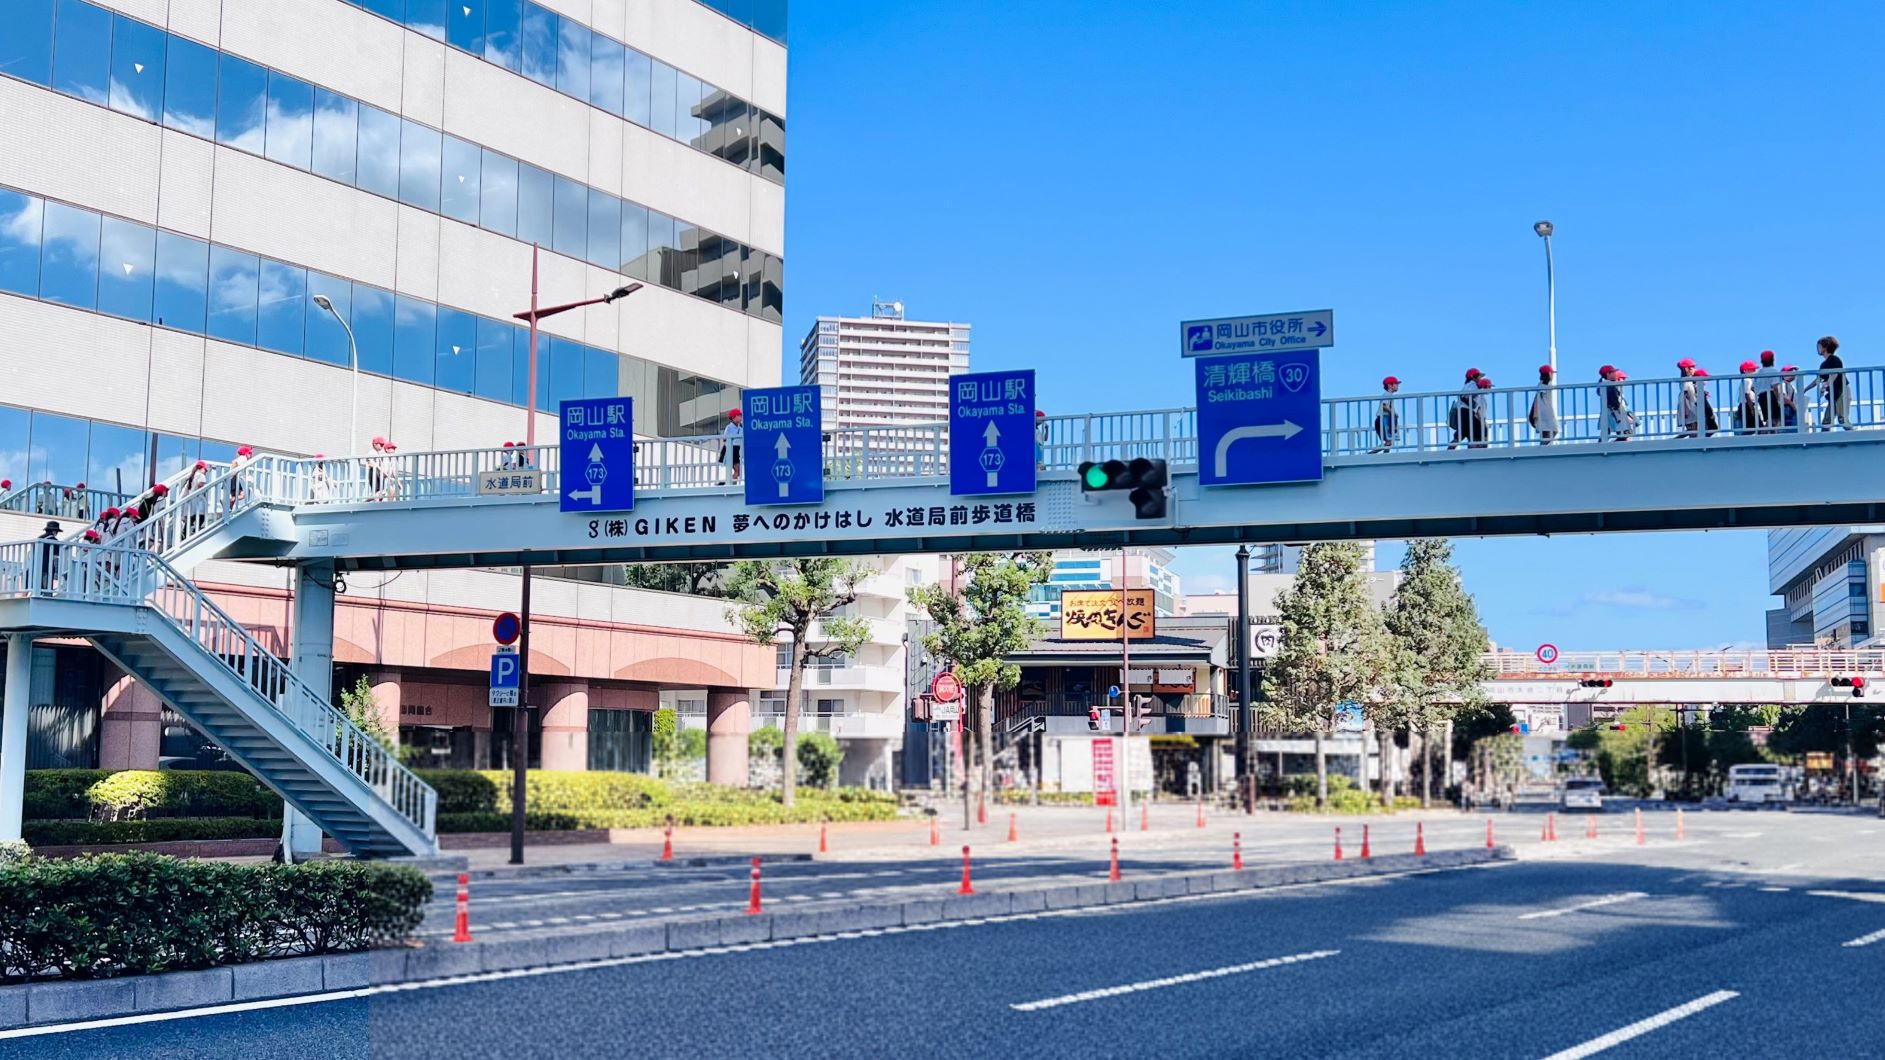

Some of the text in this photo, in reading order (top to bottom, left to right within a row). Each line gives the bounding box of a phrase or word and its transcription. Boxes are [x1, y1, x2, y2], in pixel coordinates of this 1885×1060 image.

[1216, 318, 1303, 339] 岡山市役所
[1215, 336, 1306, 350] Okayama City Office
[1204, 361, 1276, 388] 清輝橋
[1286, 368, 1302, 383] 30
[958, 378, 1026, 403] 岡山駅
[1208, 387, 1273, 403] Seikibashi
[750, 392, 813, 416] 岡山駅
[958, 403, 1025, 419] Okayama Sta.
[567, 404, 625, 426] 岡山駅
[751, 416, 813, 431] Okayama Sta.
[567, 427, 625, 441] Okayama Sta.
[983, 453, 1001, 465] 173
[588, 467, 604, 479] 173
[775, 464, 791, 477] 173
[485, 475, 534, 490] 水道局前
[733, 510, 872, 532] 夢へのかけはし
[885, 502, 1036, 528] 水道局前歩道橋
[1542, 648, 1554, 659] 40
[498, 657, 514, 684] P
